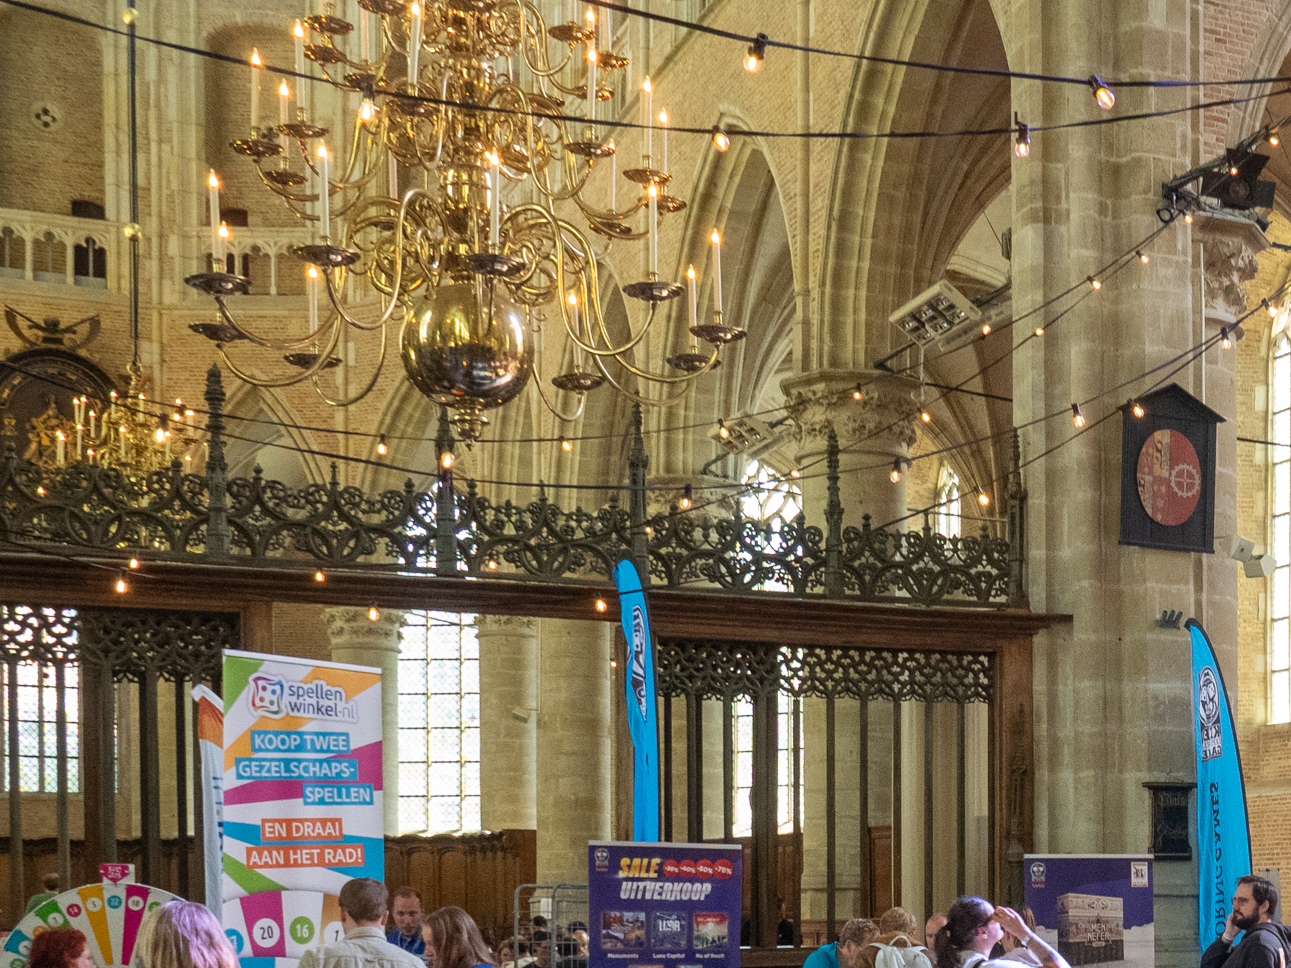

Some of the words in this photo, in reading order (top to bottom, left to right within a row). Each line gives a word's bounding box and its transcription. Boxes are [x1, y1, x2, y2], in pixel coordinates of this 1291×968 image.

[288, 684, 343, 701] spellen
[254, 734, 300, 750] KOOP
[303, 735, 347, 750] TWEE
[238, 760, 355, 778] GEZELSCHAPS-
[305, 786, 371, 803] SPELLEN
[265, 822, 287, 837] EN
[292, 821, 340, 837] DRAAI
[250, 850, 285, 866] AAN
[289, 849, 319, 864] HET
[324, 847, 362, 863] RAD!
[618, 857, 661, 878] SALE
[620, 881, 712, 901] UITVERKOOP
[260, 925, 274, 940] 20
[296, 924, 309, 938] 16
[1087, 932, 1110, 941] NEFER
